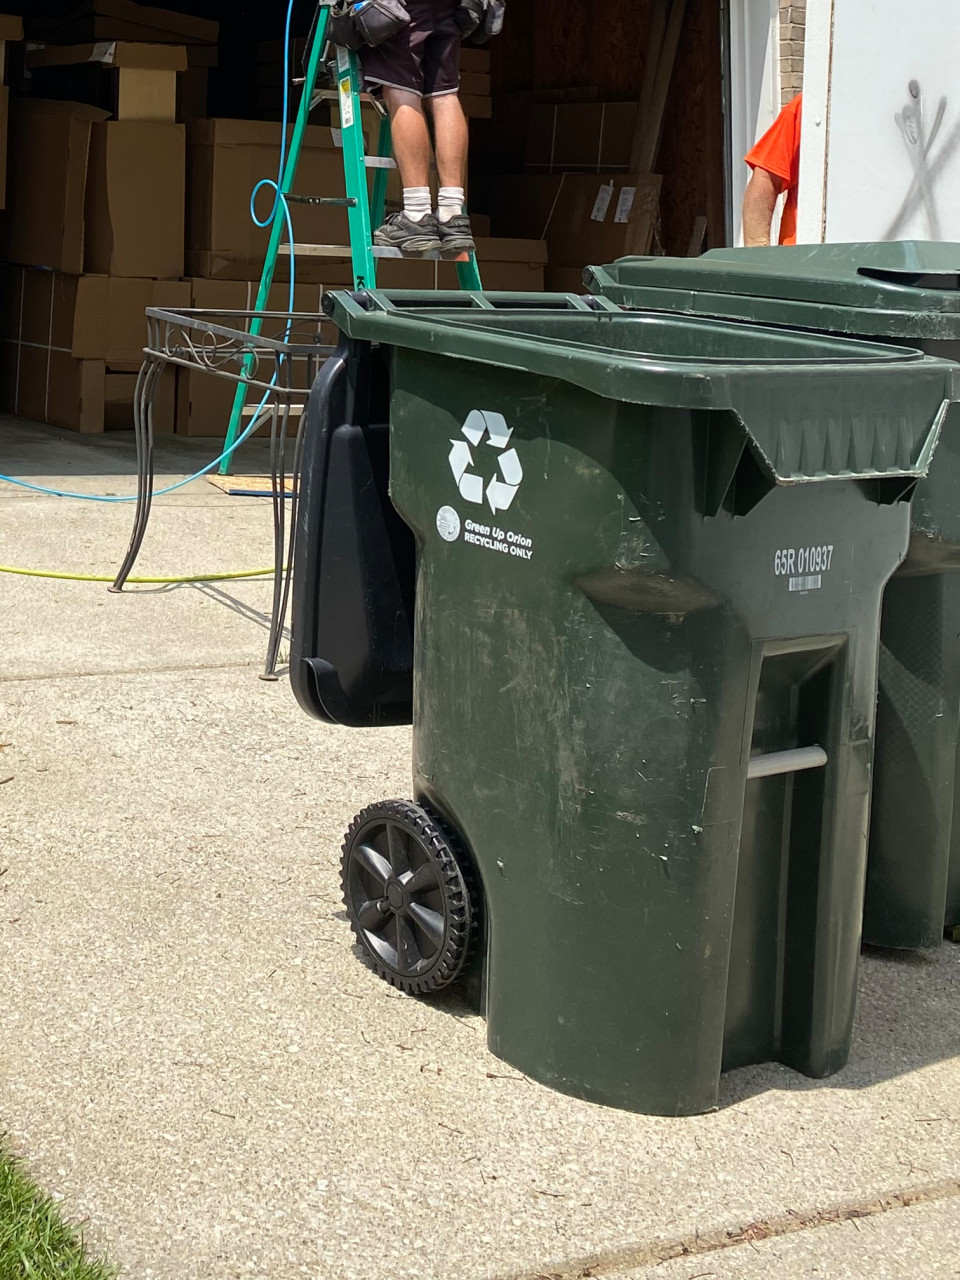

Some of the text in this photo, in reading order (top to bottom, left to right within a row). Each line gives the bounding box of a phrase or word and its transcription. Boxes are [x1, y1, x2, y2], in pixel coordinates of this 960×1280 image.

[465, 519, 490, 536] Green
[492, 527, 504, 540] Up
[507, 532, 532, 547] Orion
[465, 532, 533, 560] RECYCLING ONLY
[775, 545, 833, 575] 65R 010937
